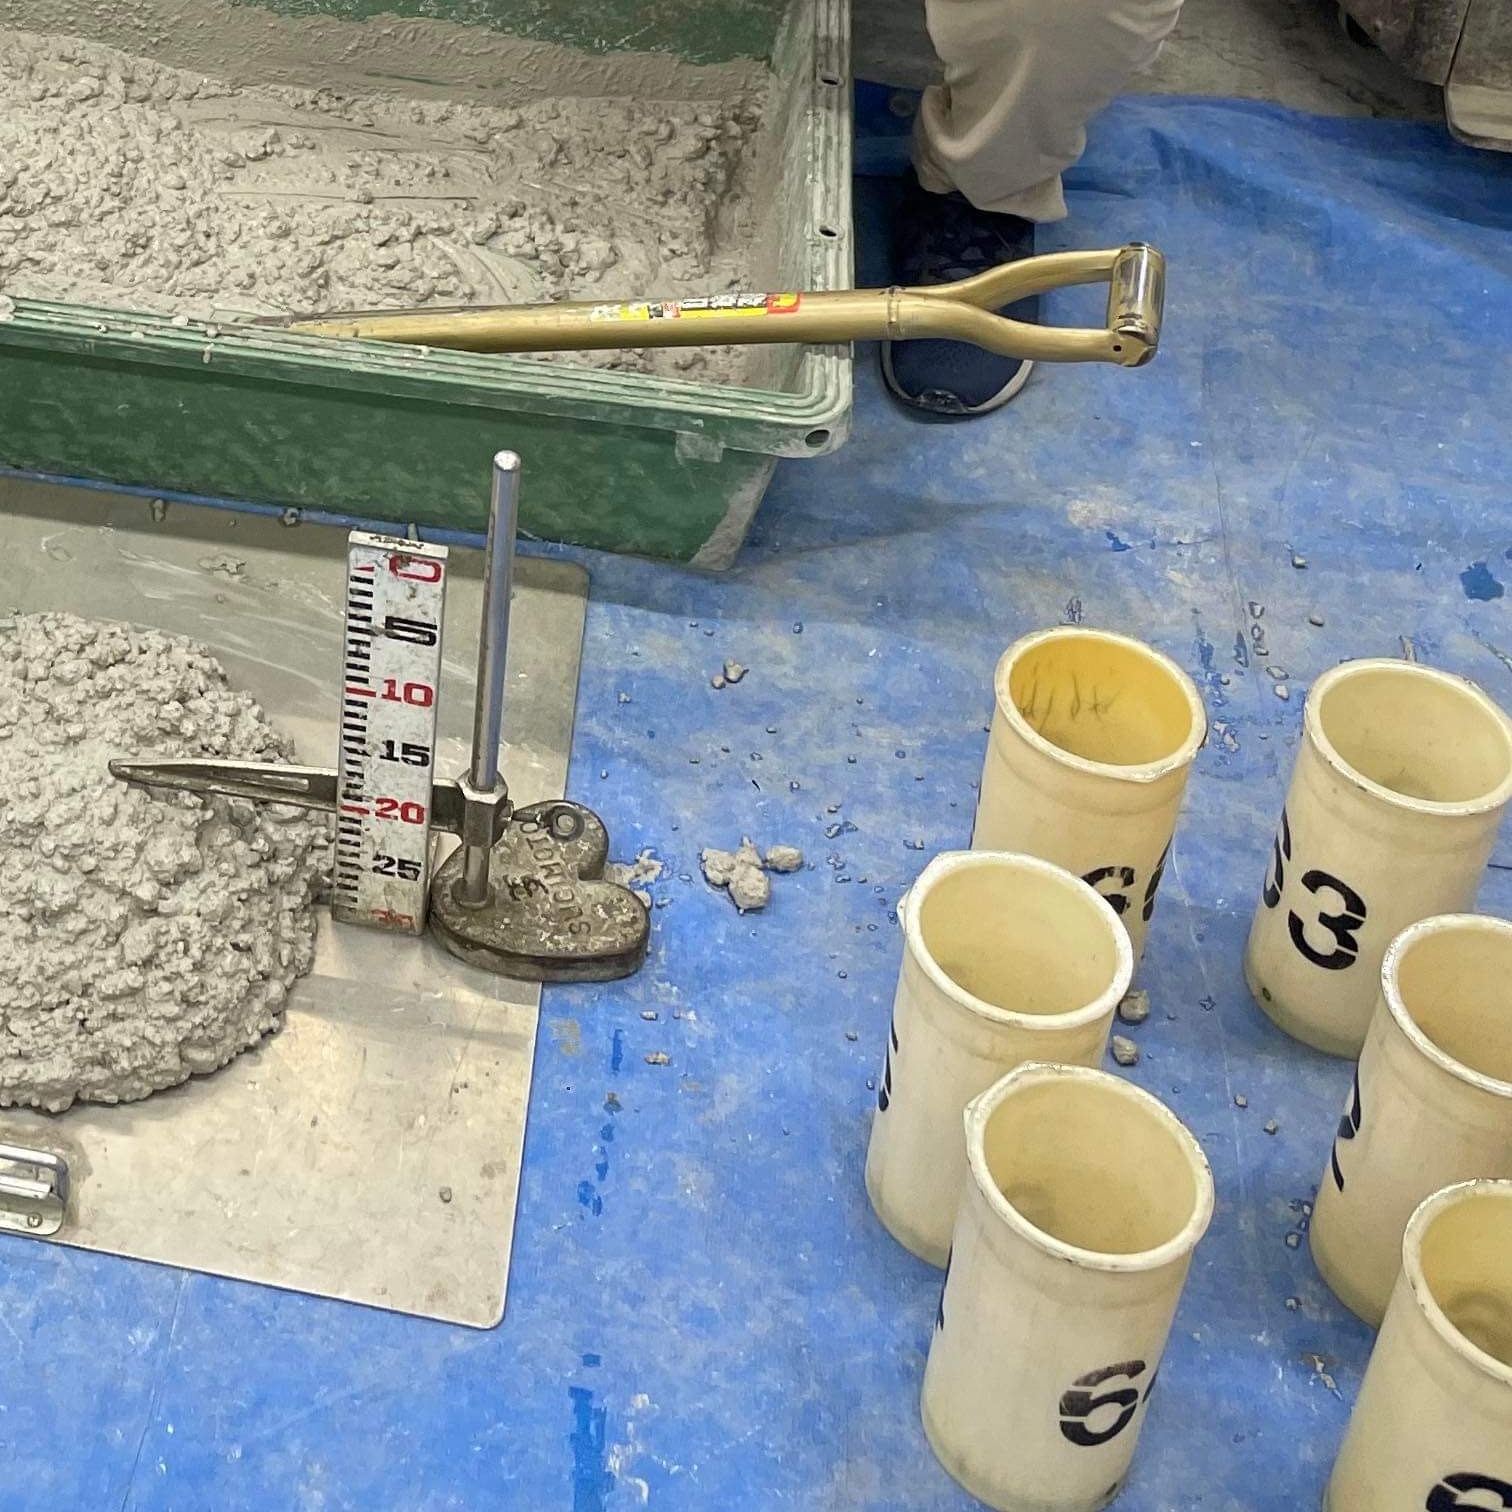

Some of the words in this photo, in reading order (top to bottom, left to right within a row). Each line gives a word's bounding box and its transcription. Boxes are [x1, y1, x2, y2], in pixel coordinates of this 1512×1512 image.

[389, 555, 442, 583] 0
[384, 615, 437, 646] 5
[381, 679, 433, 707] 10
[380, 739, 430, 767] 15
[374, 798, 425, 825] 20
[372, 854, 422, 881] 25
